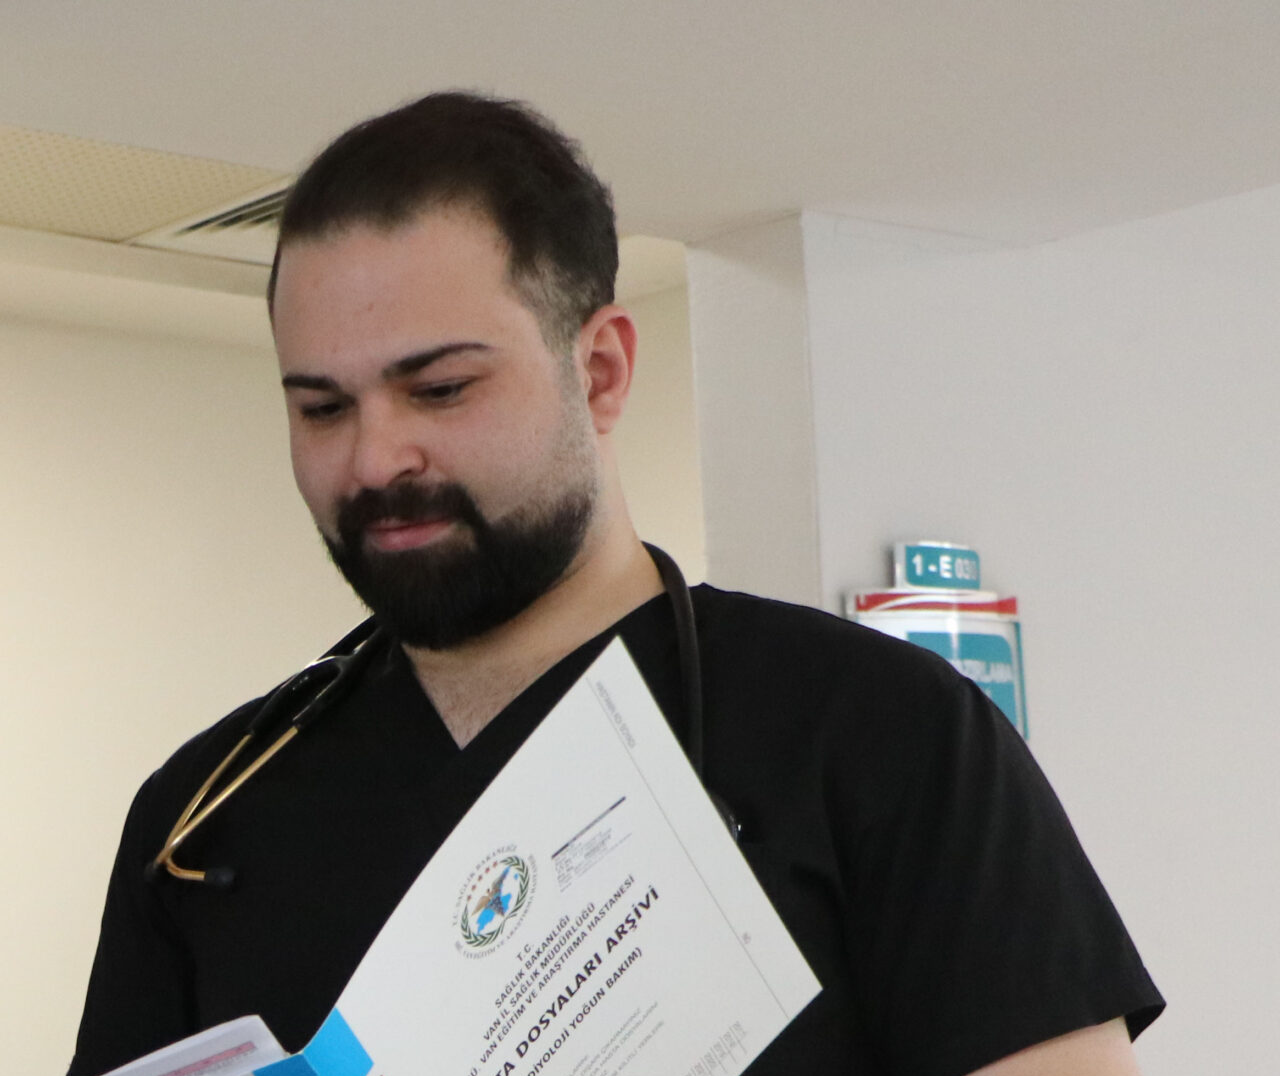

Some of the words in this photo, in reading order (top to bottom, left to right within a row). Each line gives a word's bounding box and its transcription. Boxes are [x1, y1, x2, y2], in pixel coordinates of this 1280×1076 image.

[479, 1040, 498, 1065] VAN
[495, 1002, 526, 1043] EĞİTİM
[524, 988, 538, 1006] VE
[535, 928, 588, 992] ARAŞTIRMA
[586, 872, 635, 933] HASTANESİ
[482, 1017, 501, 1042] VAN
[499, 1005, 510, 1020] İL
[508, 967, 540, 1008] SAĞLIK
[538, 899, 596, 970] MÜDÜRLÜĞÜ
[493, 967, 525, 1009] SAĞLIK
[523, 912, 571, 971] BAKANLIĞI
[514, 950, 603, 1060] DOSYALARI
[602, 882, 660, 954] ARŞİVİ
[568, 985, 606, 1031] YOĞUN
[604, 944, 643, 990] BAKIM)
